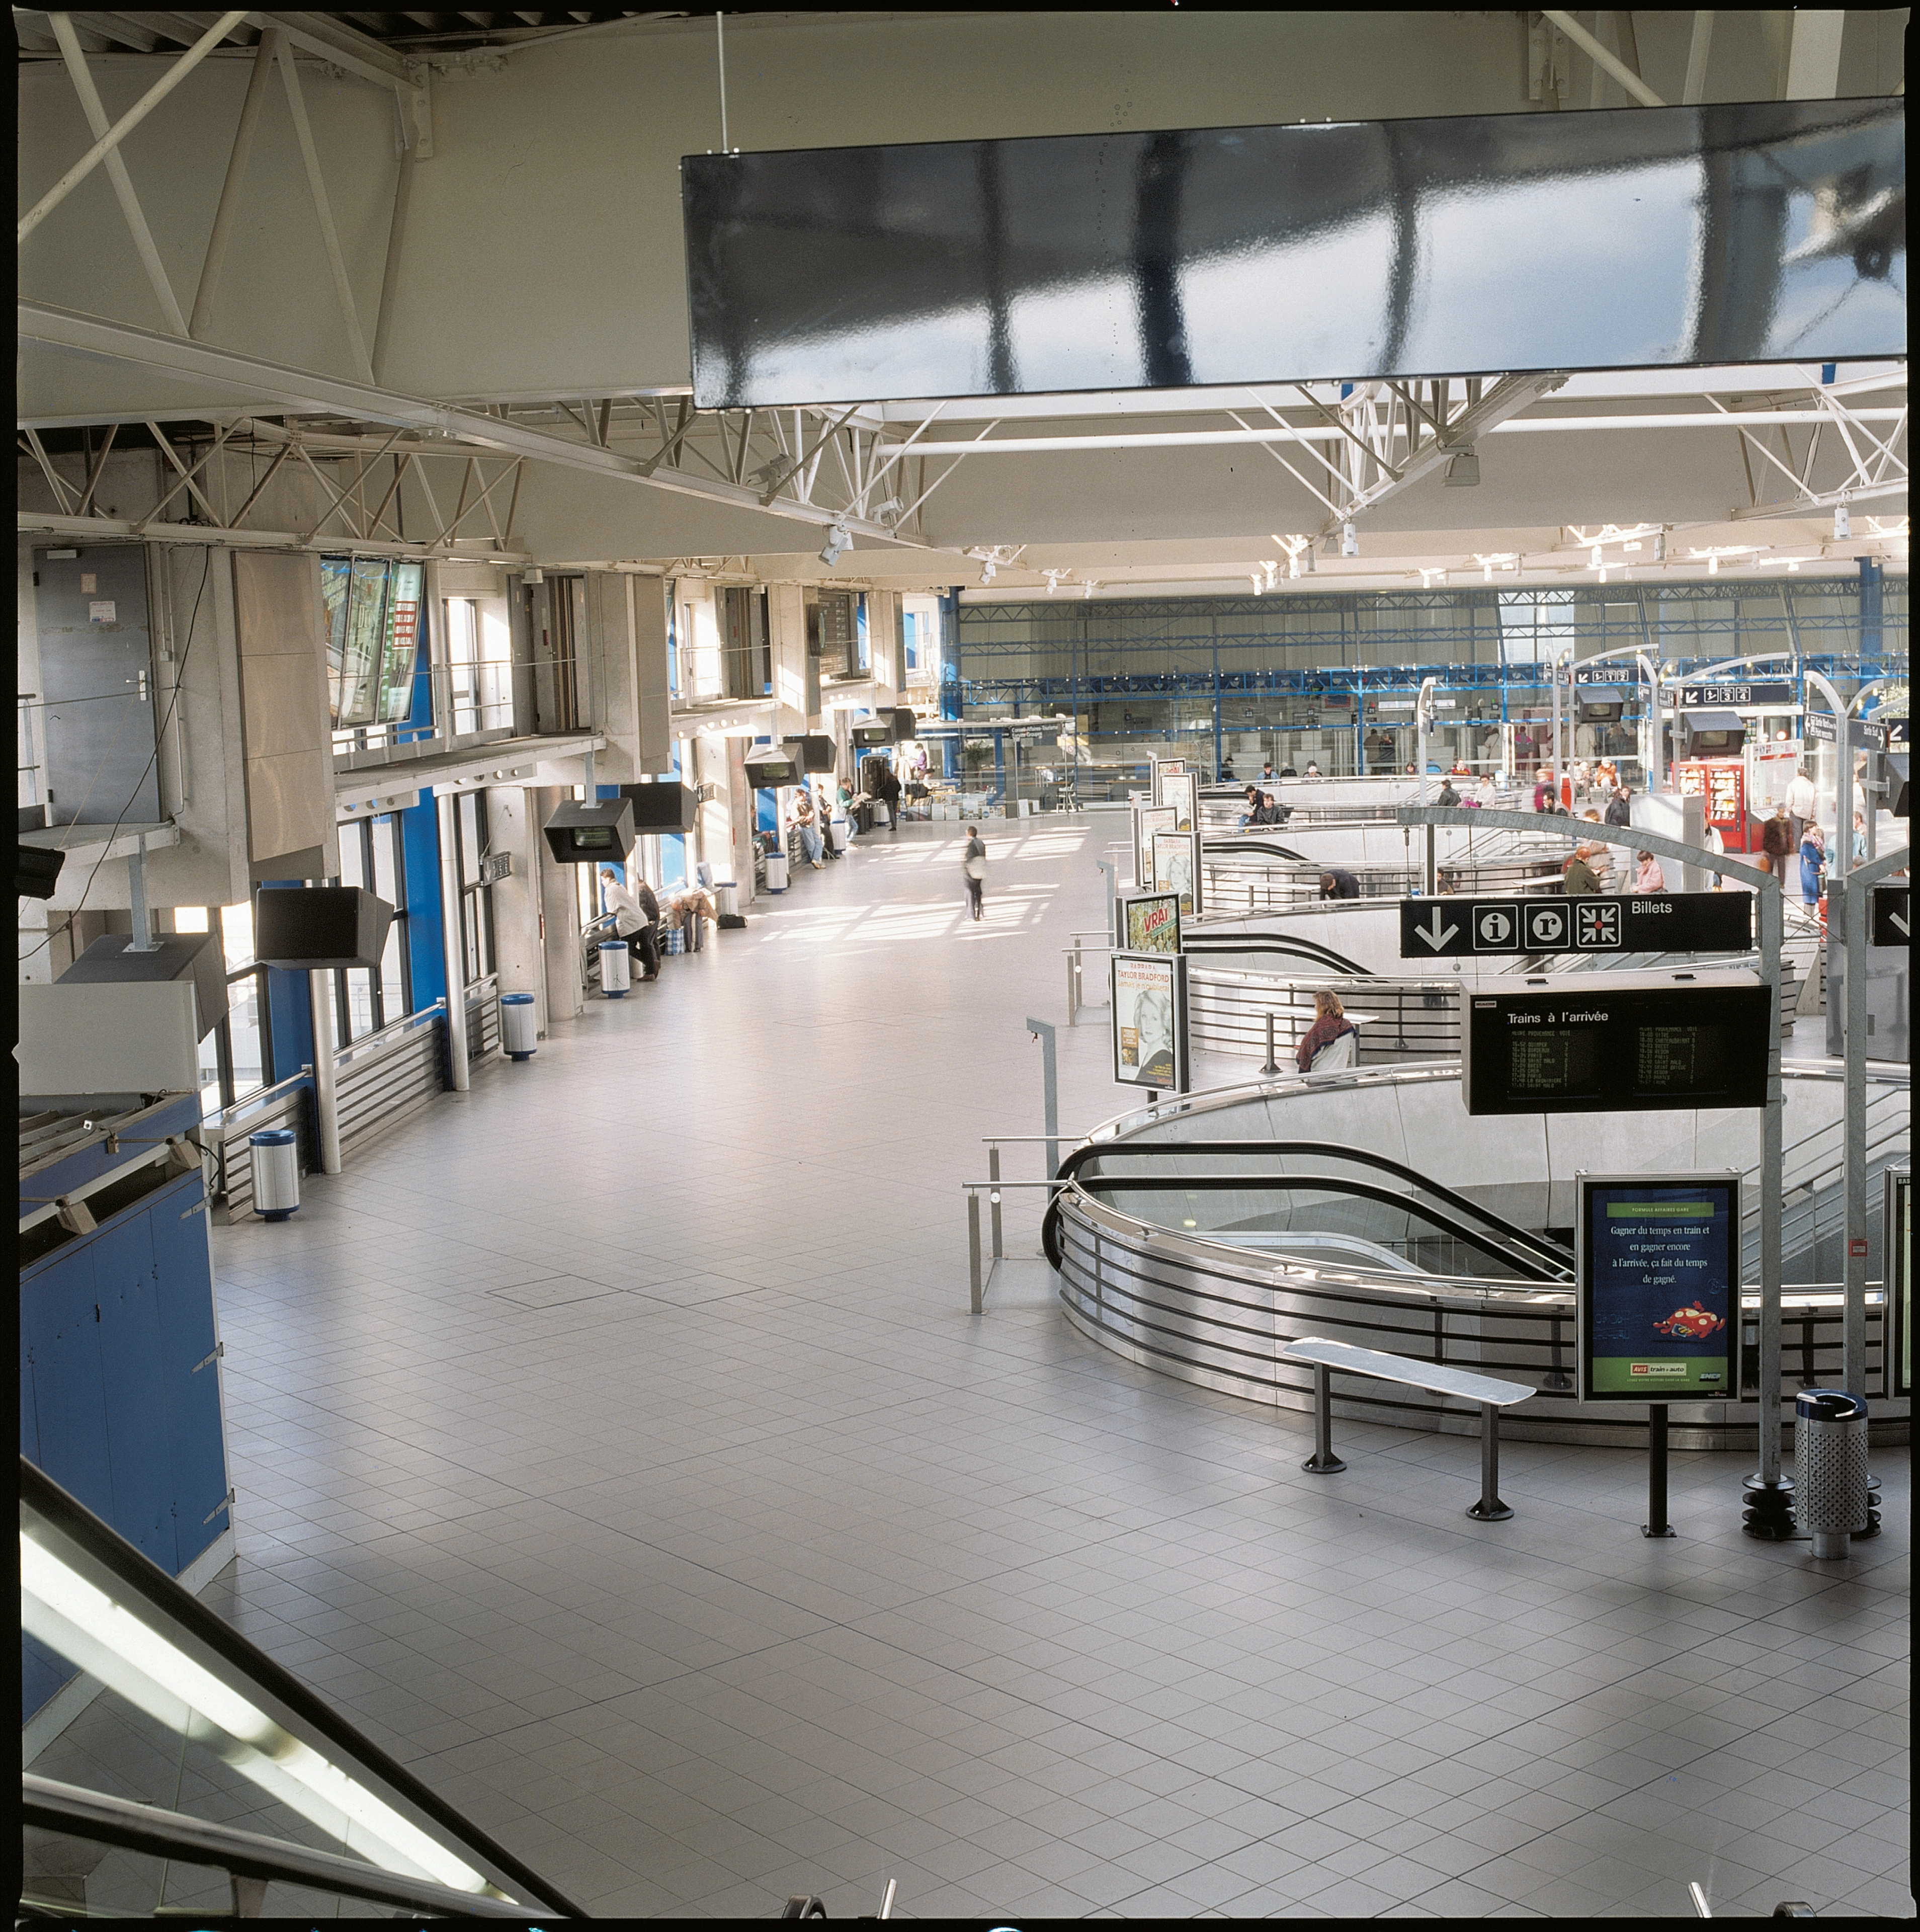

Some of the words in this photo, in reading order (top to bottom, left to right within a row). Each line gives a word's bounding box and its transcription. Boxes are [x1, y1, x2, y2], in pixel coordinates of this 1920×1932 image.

[499, 865, 502, 875] 5
[505, 863, 508, 873] 6
[1631, 901, 1673, 914] Billets
[1144, 908, 1168, 932] VRAI
[1118, 970, 1137, 979] TAYLOR
[1138, 973, 1169, 982] BRADFORD
[1118, 979, 1134, 988] Jamais
[1136, 981, 1140, 990] je
[1142, 982, 1169, 992] n'oublierai
[1508, 1013, 1541, 1023] Trains
[1548, 1013, 1555, 1022] à
[1562, 1011, 1608, 1022] l'arrivée
[1611, 1226, 1637, 1236] Gagner
[1638, 1226, 1647, 1235] du
[1649, 1227, 1671, 1237] temps
[1684, 1226, 1701, 1235] train
[1641, 1244, 1665, 1253] gagner
[1613, 1259, 1617, 1267] à
[1619, 1258, 1649, 1268] l'arrivée,
[1651, 1260, 1659, 1268] ça
[1661, 1258, 1672, 1267] fait
[1674, 1258, 1684, 1267] du
[1686, 1259, 1708, 1269] temps
[1643, 1274, 1651, 1283] de
[1653, 1275, 1677, 1284] gagné.
